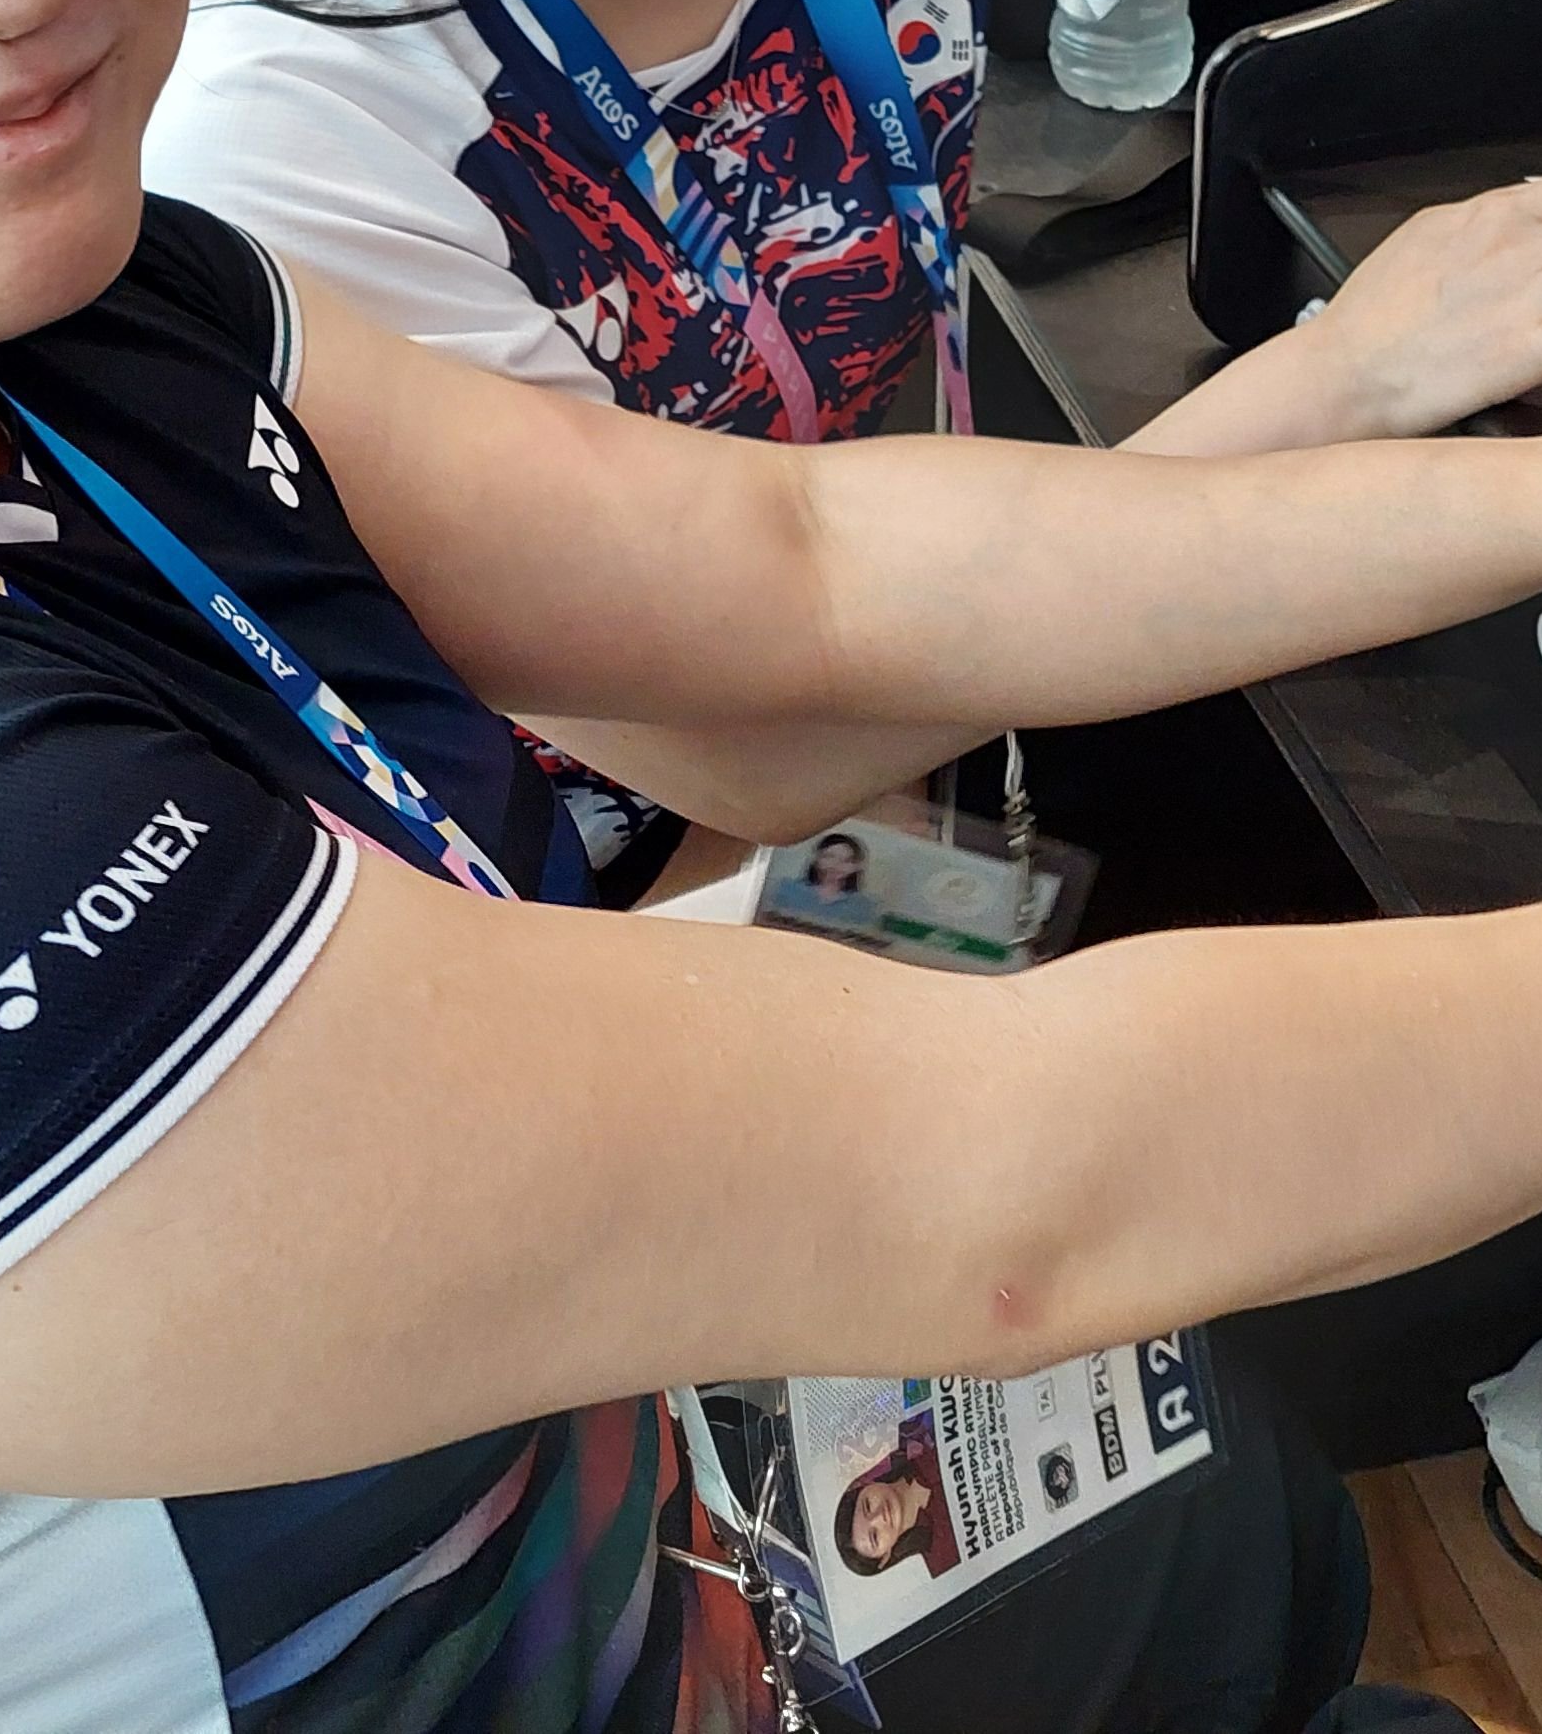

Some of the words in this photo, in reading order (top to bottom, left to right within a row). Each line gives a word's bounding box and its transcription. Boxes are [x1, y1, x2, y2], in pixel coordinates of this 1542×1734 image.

[571, 65, 640, 141] Atos
[868, 97, 919, 172] Atos
[209, 593, 300, 681] Atos
[39, 799, 211, 959] YONEX
[989, 1439, 1001, 1457] of
[996, 1412, 1008, 1434] de
[1098, 1410, 1124, 1475] BDM
[946, 1445, 982, 1560] Hyunah
[967, 1437, 995, 1550] PARALYMPIC
[994, 1460, 1015, 1537] Republic
[1003, 1438, 1026, 1532] République
